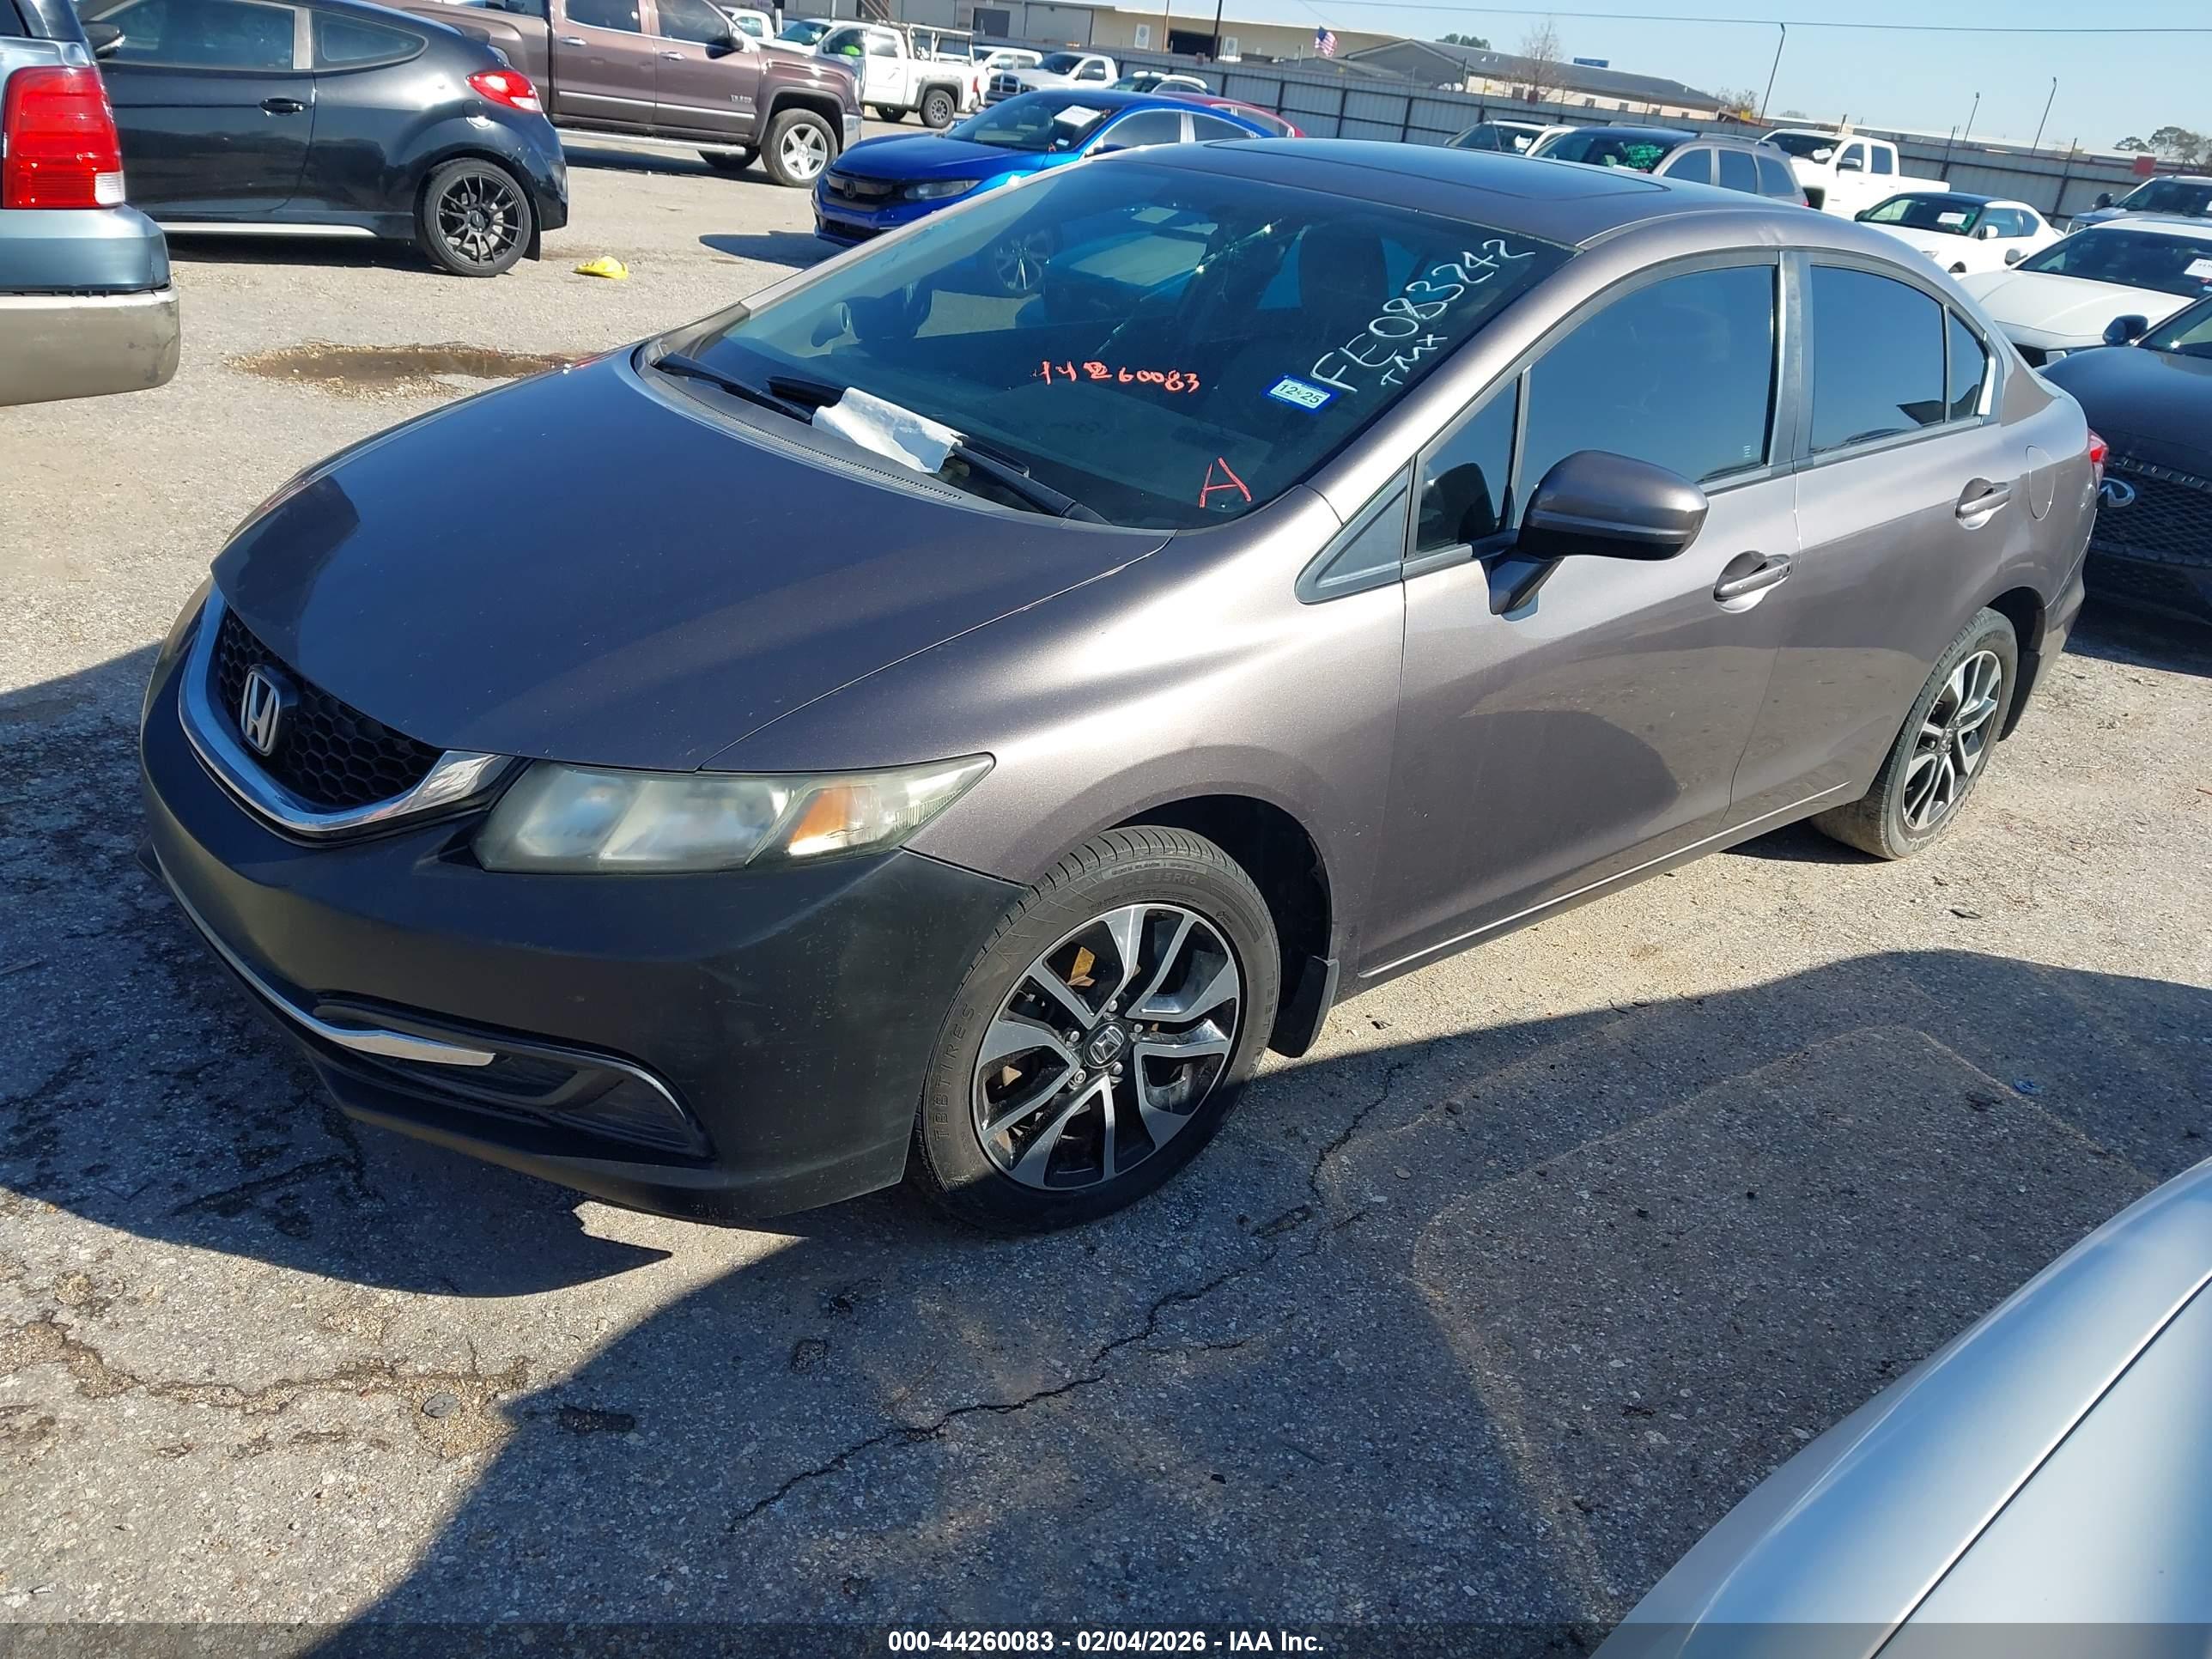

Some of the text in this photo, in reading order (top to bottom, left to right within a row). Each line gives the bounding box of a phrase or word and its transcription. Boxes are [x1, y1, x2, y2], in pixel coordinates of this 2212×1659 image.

[1310, 239, 1536, 392] FE083242
[1279, 383, 1322, 404] 12 25
[1199, 457, 1252, 508] A
